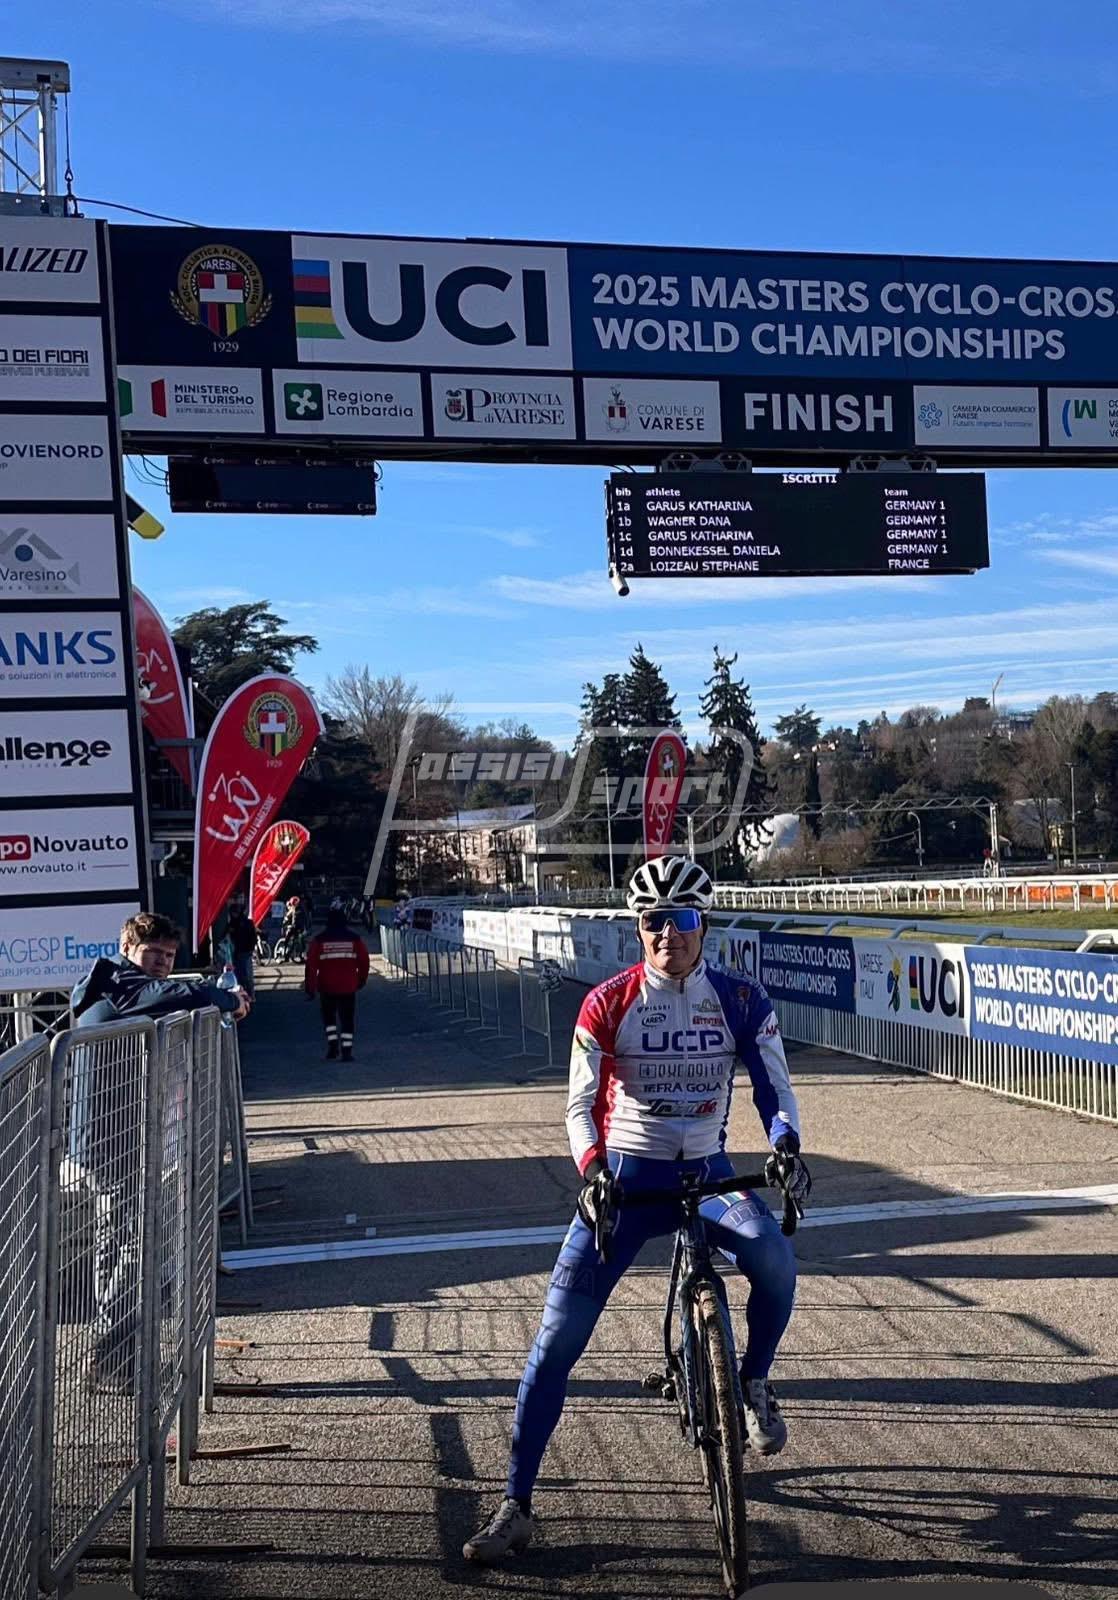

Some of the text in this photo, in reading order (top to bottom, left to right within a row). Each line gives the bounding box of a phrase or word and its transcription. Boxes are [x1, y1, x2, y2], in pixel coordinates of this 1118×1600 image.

[200, 259, 237, 271] VARESE
[592, 273, 1118, 318] 2025 MASTERS CYCLO-CROS
[341, 260, 550, 347] UCI
[592, 317, 1066, 360] WORLD CHAMPIONSHIPS
[212, 341, 240, 352] 1929
[13, 349, 41, 363] DEI
[45, 350, 89, 363] FIORI
[174, 384, 239, 394] MINISTERO
[175, 394, 255, 405] DEL TURISMO
[327, 389, 394, 405] Regione
[327, 404, 414, 417] Lombardia
[459, 387, 563, 422] PROVINCIA
[637, 405, 705, 416] COMUNE DI
[952, 405, 983, 413] CAMERA
[744, 392, 894, 433] FINISH
[640, 417, 705, 431] VARESE
[0, 444, 104, 458] OVIENORD
[782, 473, 838, 484] ISCRITTI
[615, 488, 908, 497] bib athlete team
[617, 500, 945, 511] 1a GARUS KATHARINA GERMANY 1
[618, 515, 946, 527] 1b WAGNER DANA GERMANY 1
[619, 530, 947, 542] 1c GARUS KATHARINA GERMANY 1
[620, 544, 948, 557] 1d BONNEKESSEL DANIELA GERMANY 1
[620, 558, 930, 572] 2a LOIZEAU STEPHANE FRANCE
[0, 568, 66, 581] Varesino
[8, 670, 51, 680] soluzioni
[54, 671, 62, 679] in
[65, 669, 117, 679] elettronica
[0, 736, 112, 767] llenge
[34, 834, 129, 853] Novauto
[0, 936, 60, 964] AGESP
[774, 943, 804, 964] MASTERS
[803, 944, 851, 970] CYCLO-CROSS
[859, 953, 884, 974] VARESE
[762, 967, 784, 988] WORLD
[785, 970, 837, 996] CHAMPIONSHIPS
[970, 962, 997, 989] 2025
[997, 963, 1053, 996] MASTERS
[918, 956, 965, 1018] UCI
[974, 996, 1014, 1028] WORLD
[642, 1030, 724, 1053] UCP
